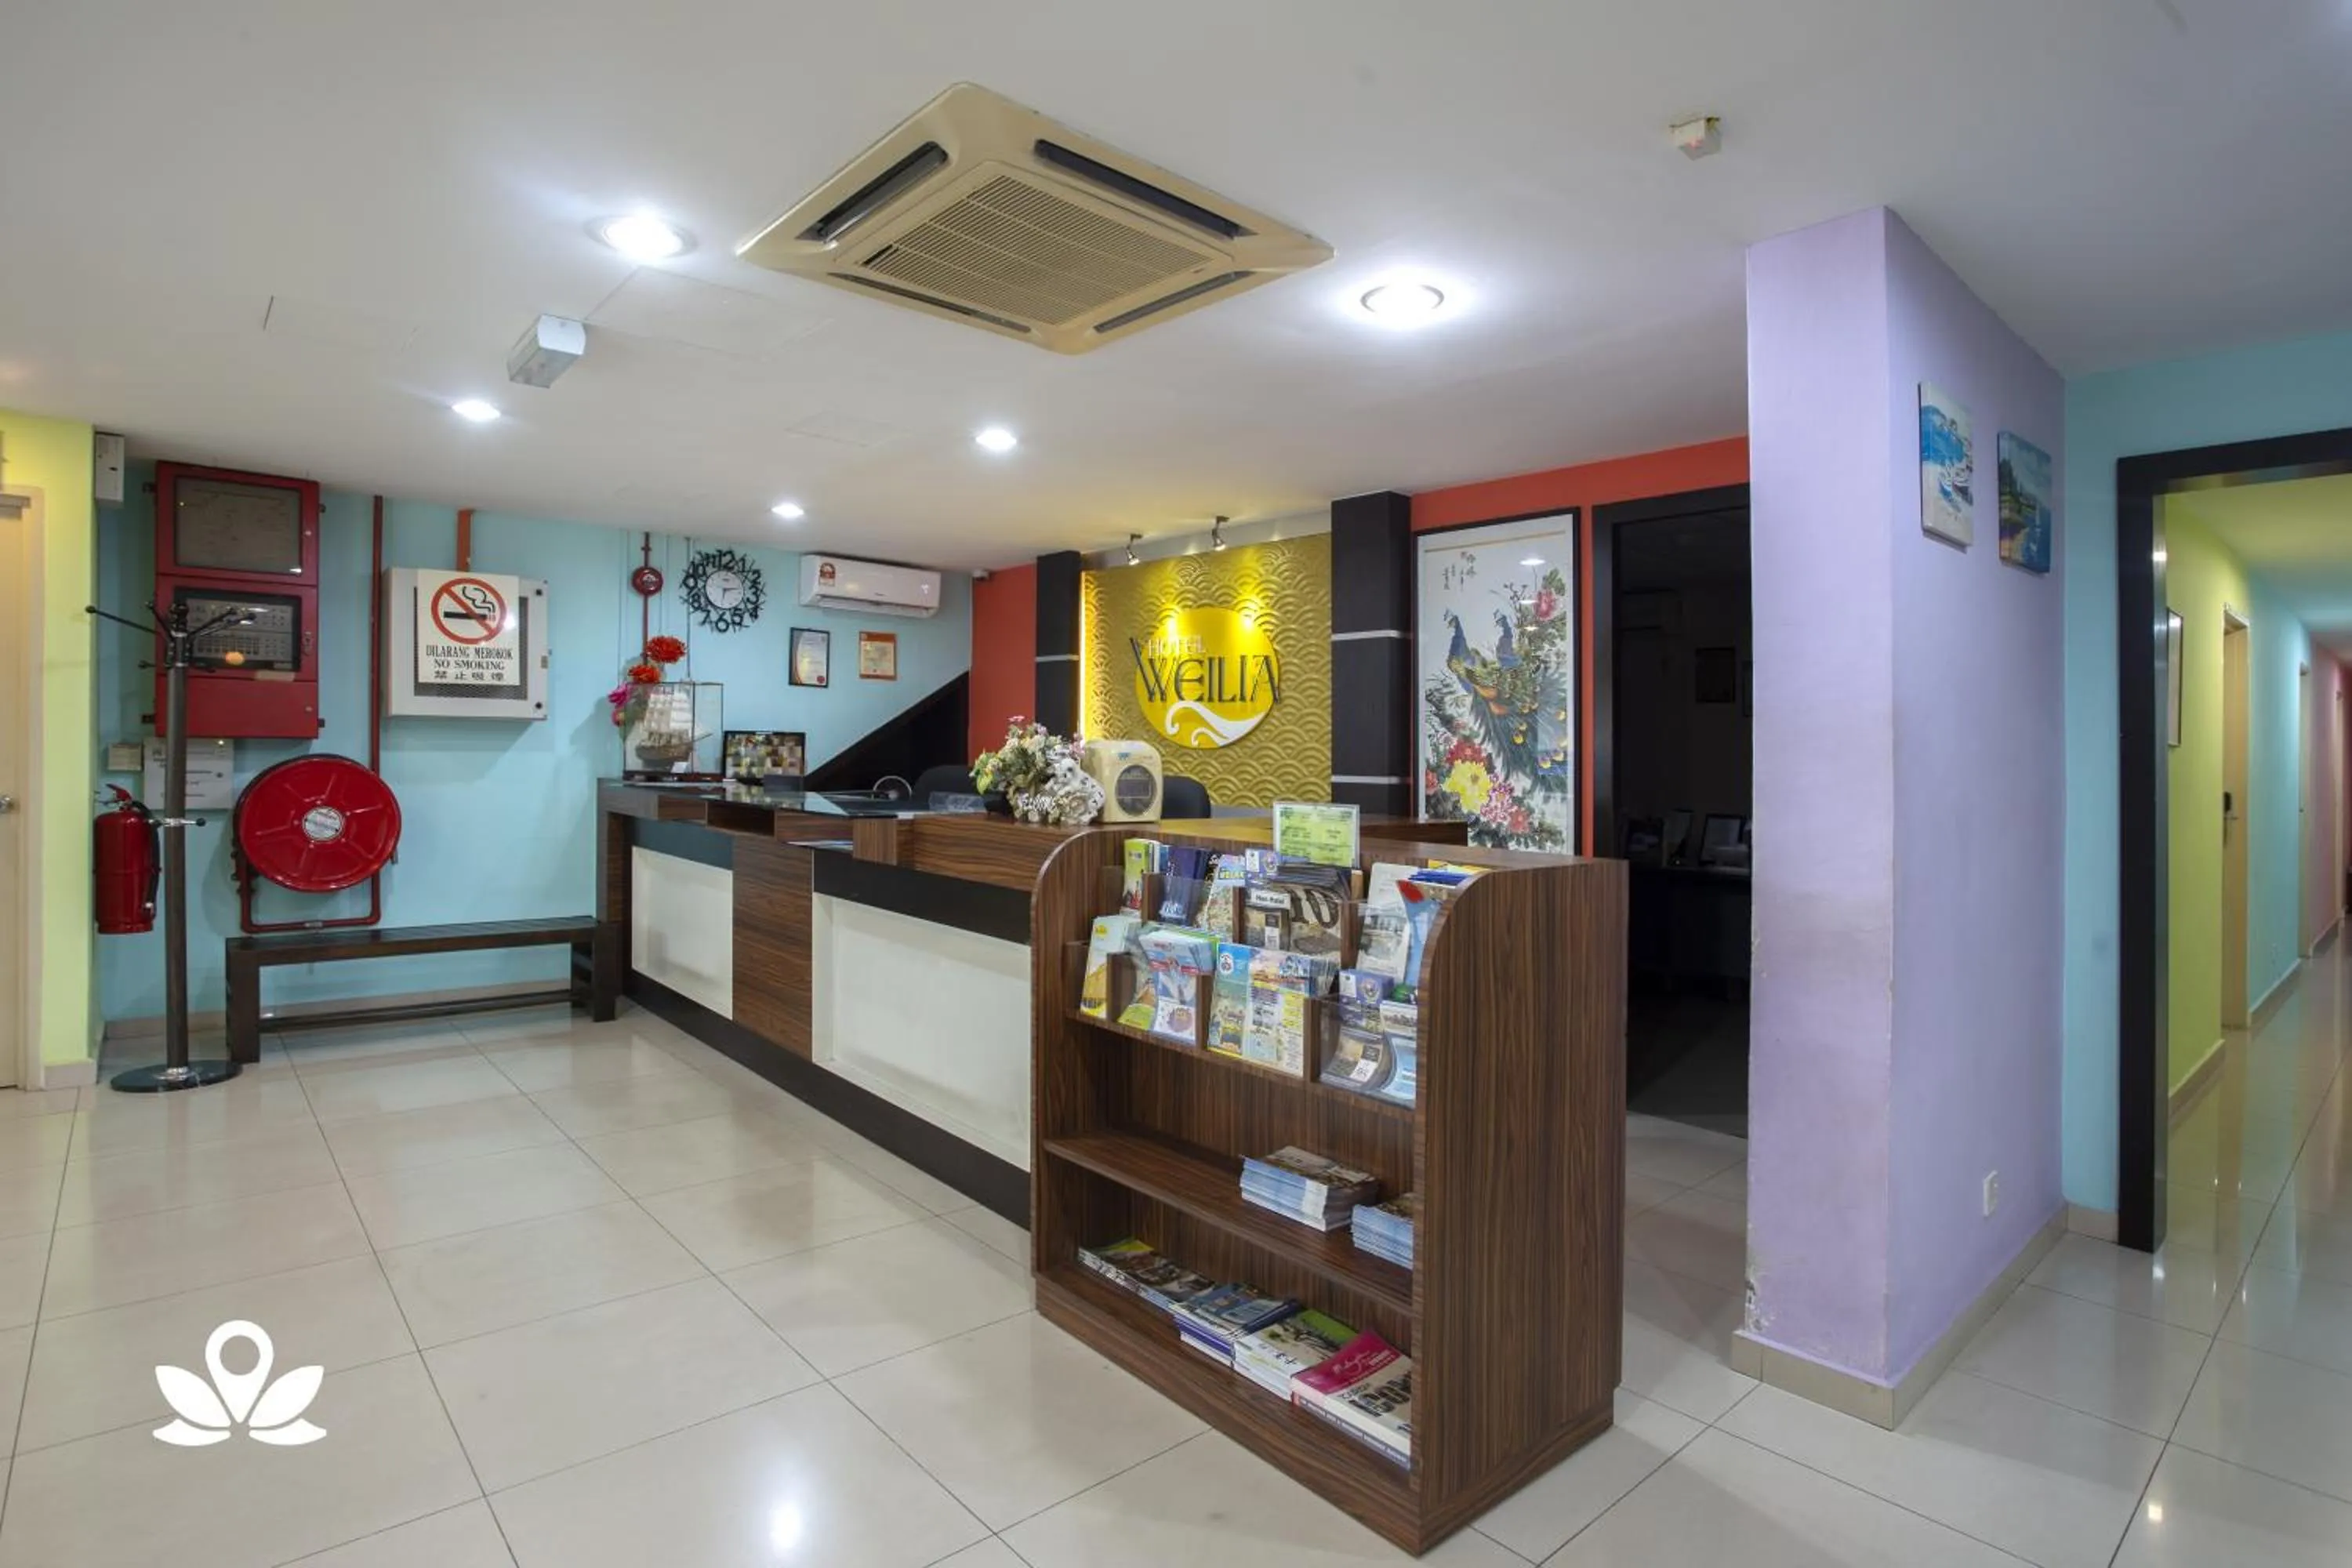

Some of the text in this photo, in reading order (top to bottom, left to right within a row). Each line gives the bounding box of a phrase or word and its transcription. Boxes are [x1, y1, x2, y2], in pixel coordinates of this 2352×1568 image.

[716, 550, 735, 571] 12
[752, 568, 760, 585] 2
[691, 593, 701, 609] 8
[746, 585, 759, 604] 3
[715, 612, 729, 633] 6
[426, 644, 513, 659] DILARANG MEROKOK
[1148, 635, 1206, 658] HOTEL
[434, 659, 505, 670] NO SMOKING
[1129, 637, 1279, 703] WEILIA
